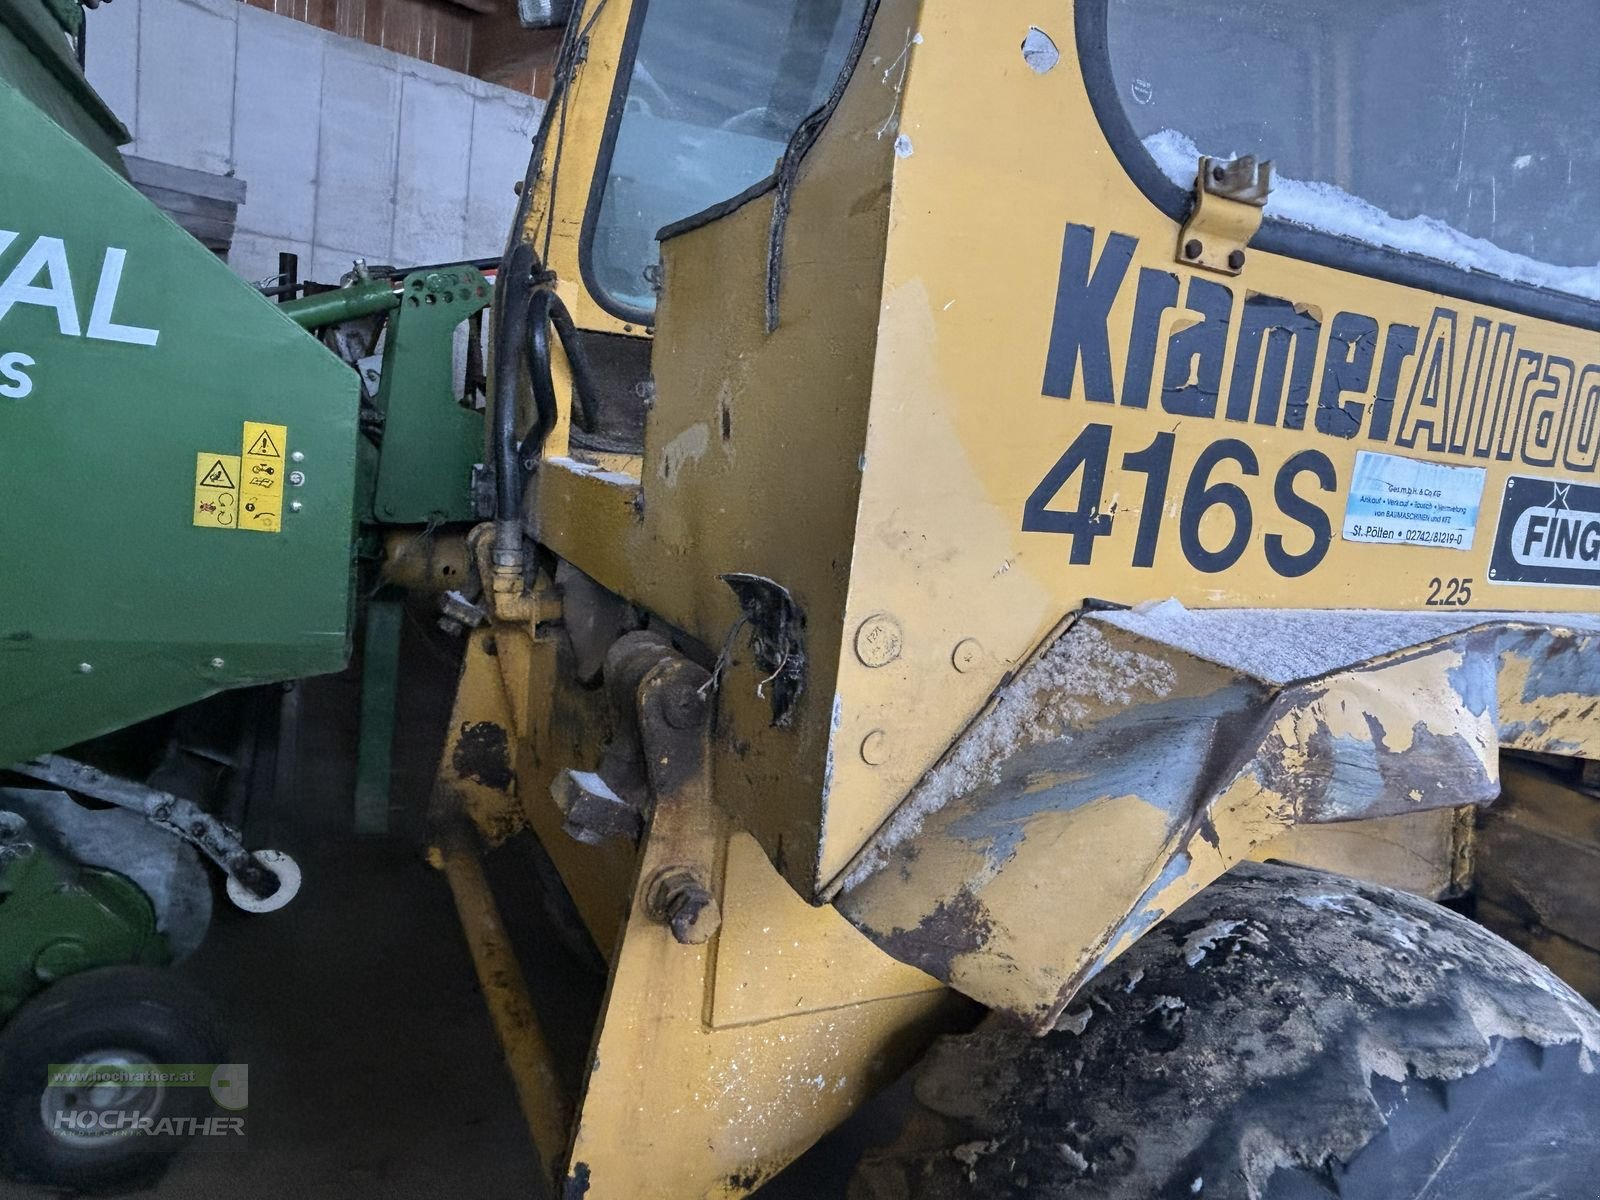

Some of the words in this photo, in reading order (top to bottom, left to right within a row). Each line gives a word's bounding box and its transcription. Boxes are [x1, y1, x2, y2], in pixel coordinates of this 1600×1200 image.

[0, 230, 160, 345] AL
[1021, 422, 1337, 578] 416S
[1360, 495, 1382, 504] Ankauf
[1387, 498, 1410, 508] Verkauf
[1414, 501, 1433, 509] Tausch
[1437, 504, 1467, 515] Vermietung
[1374, 510, 1385, 518] von
[1386, 510, 1430, 522] BAUMASCHINEN
[1441, 516, 1452, 524] KFZ
[1353, 524, 1364, 537] St.
[1365, 525, 1395, 539] Pölten
[1405, 529, 1463, 545] 02742/81219-0
[1425, 577, 1473, 606] 2.25
